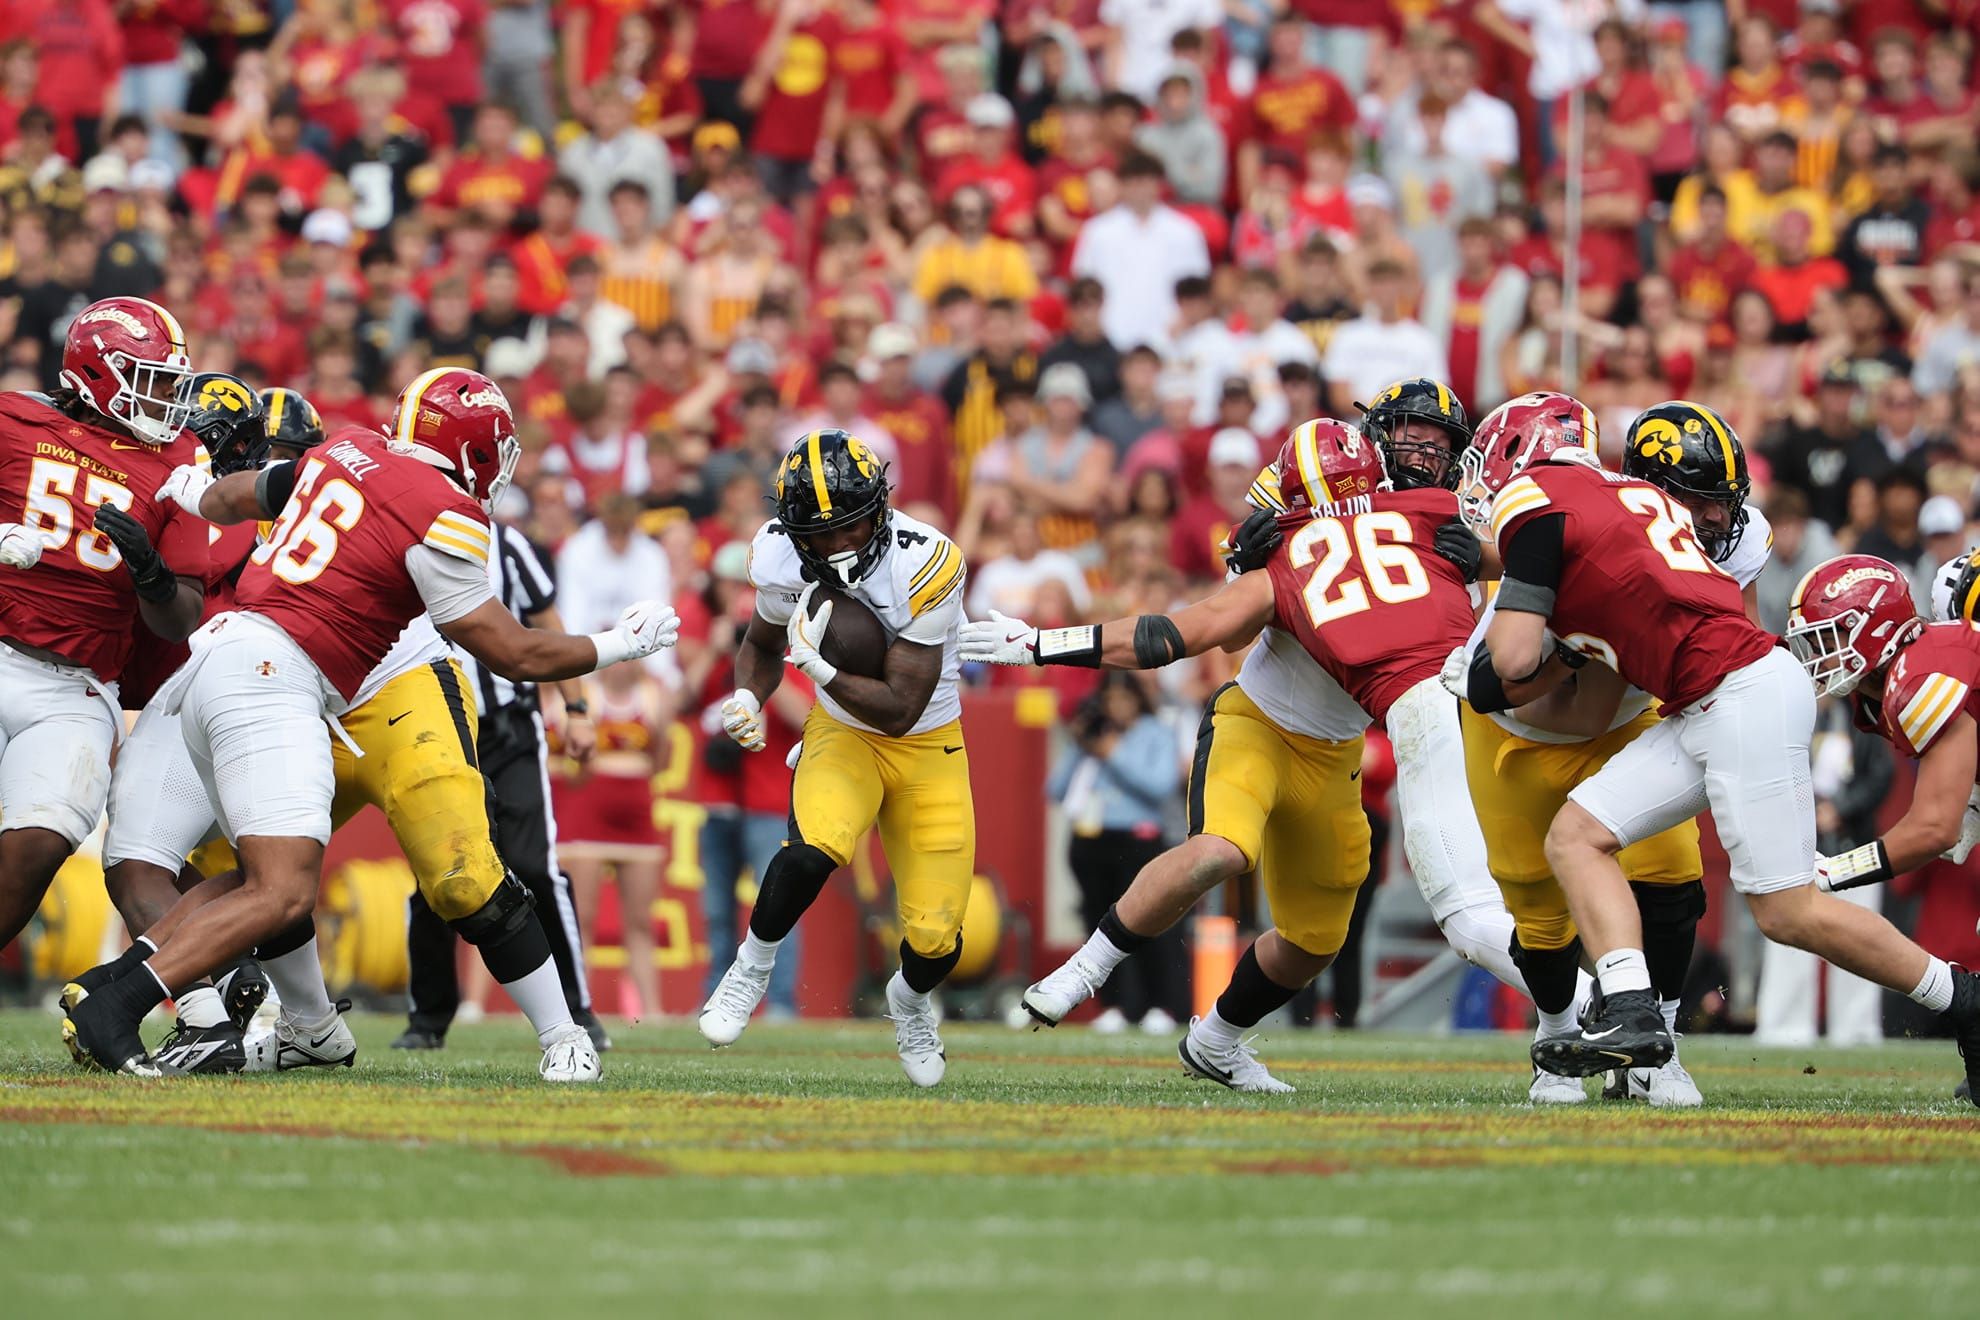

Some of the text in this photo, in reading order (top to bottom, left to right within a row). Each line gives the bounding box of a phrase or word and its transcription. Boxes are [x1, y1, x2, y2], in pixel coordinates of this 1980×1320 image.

[80, 306, 148, 338] Cyclones
[36, 442, 129, 485] IOWA STATE
[250, 456, 365, 585] 56
[897, 529, 929, 550] 4
[1288, 510, 1431, 630] 26
[1824, 567, 1896, 598] Cyclones
